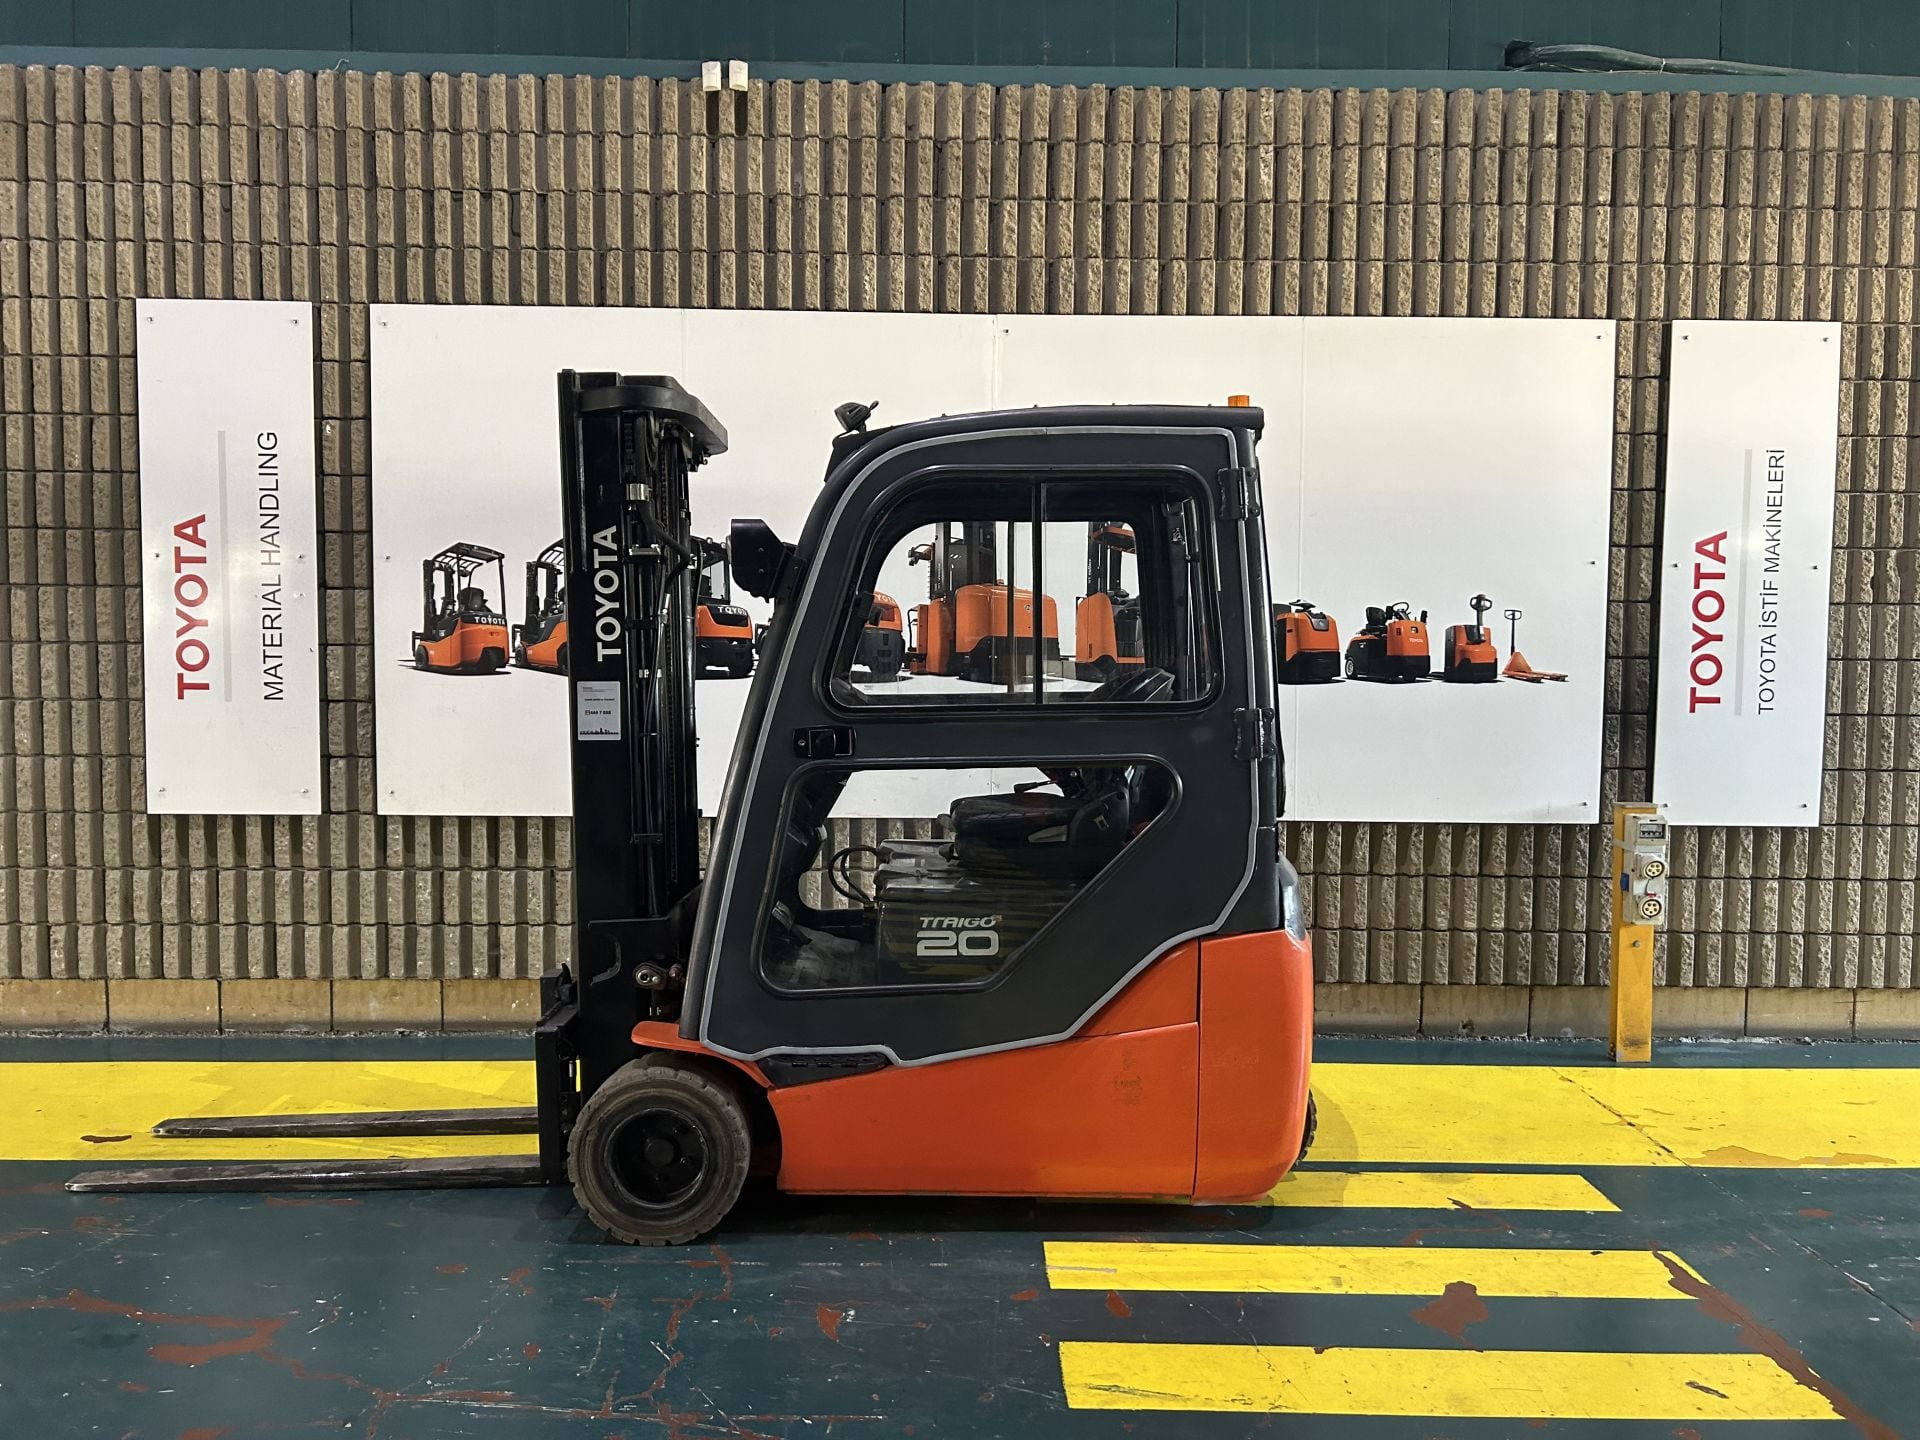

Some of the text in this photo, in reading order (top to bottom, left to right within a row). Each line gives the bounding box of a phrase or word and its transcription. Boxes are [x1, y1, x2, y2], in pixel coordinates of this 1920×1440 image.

[174, 514, 210, 700] TOYOTA
[256, 431, 284, 701] MATERIAL HANDLING
[474, 616, 506, 625] TOYOTA
[593, 525, 621, 662] TOYOTA
[1689, 531, 1727, 713] TOYOTA
[1757, 449, 1786, 715] TOYOTA İSTİF MAKİNELERİ
[916, 930, 999, 957] 20
